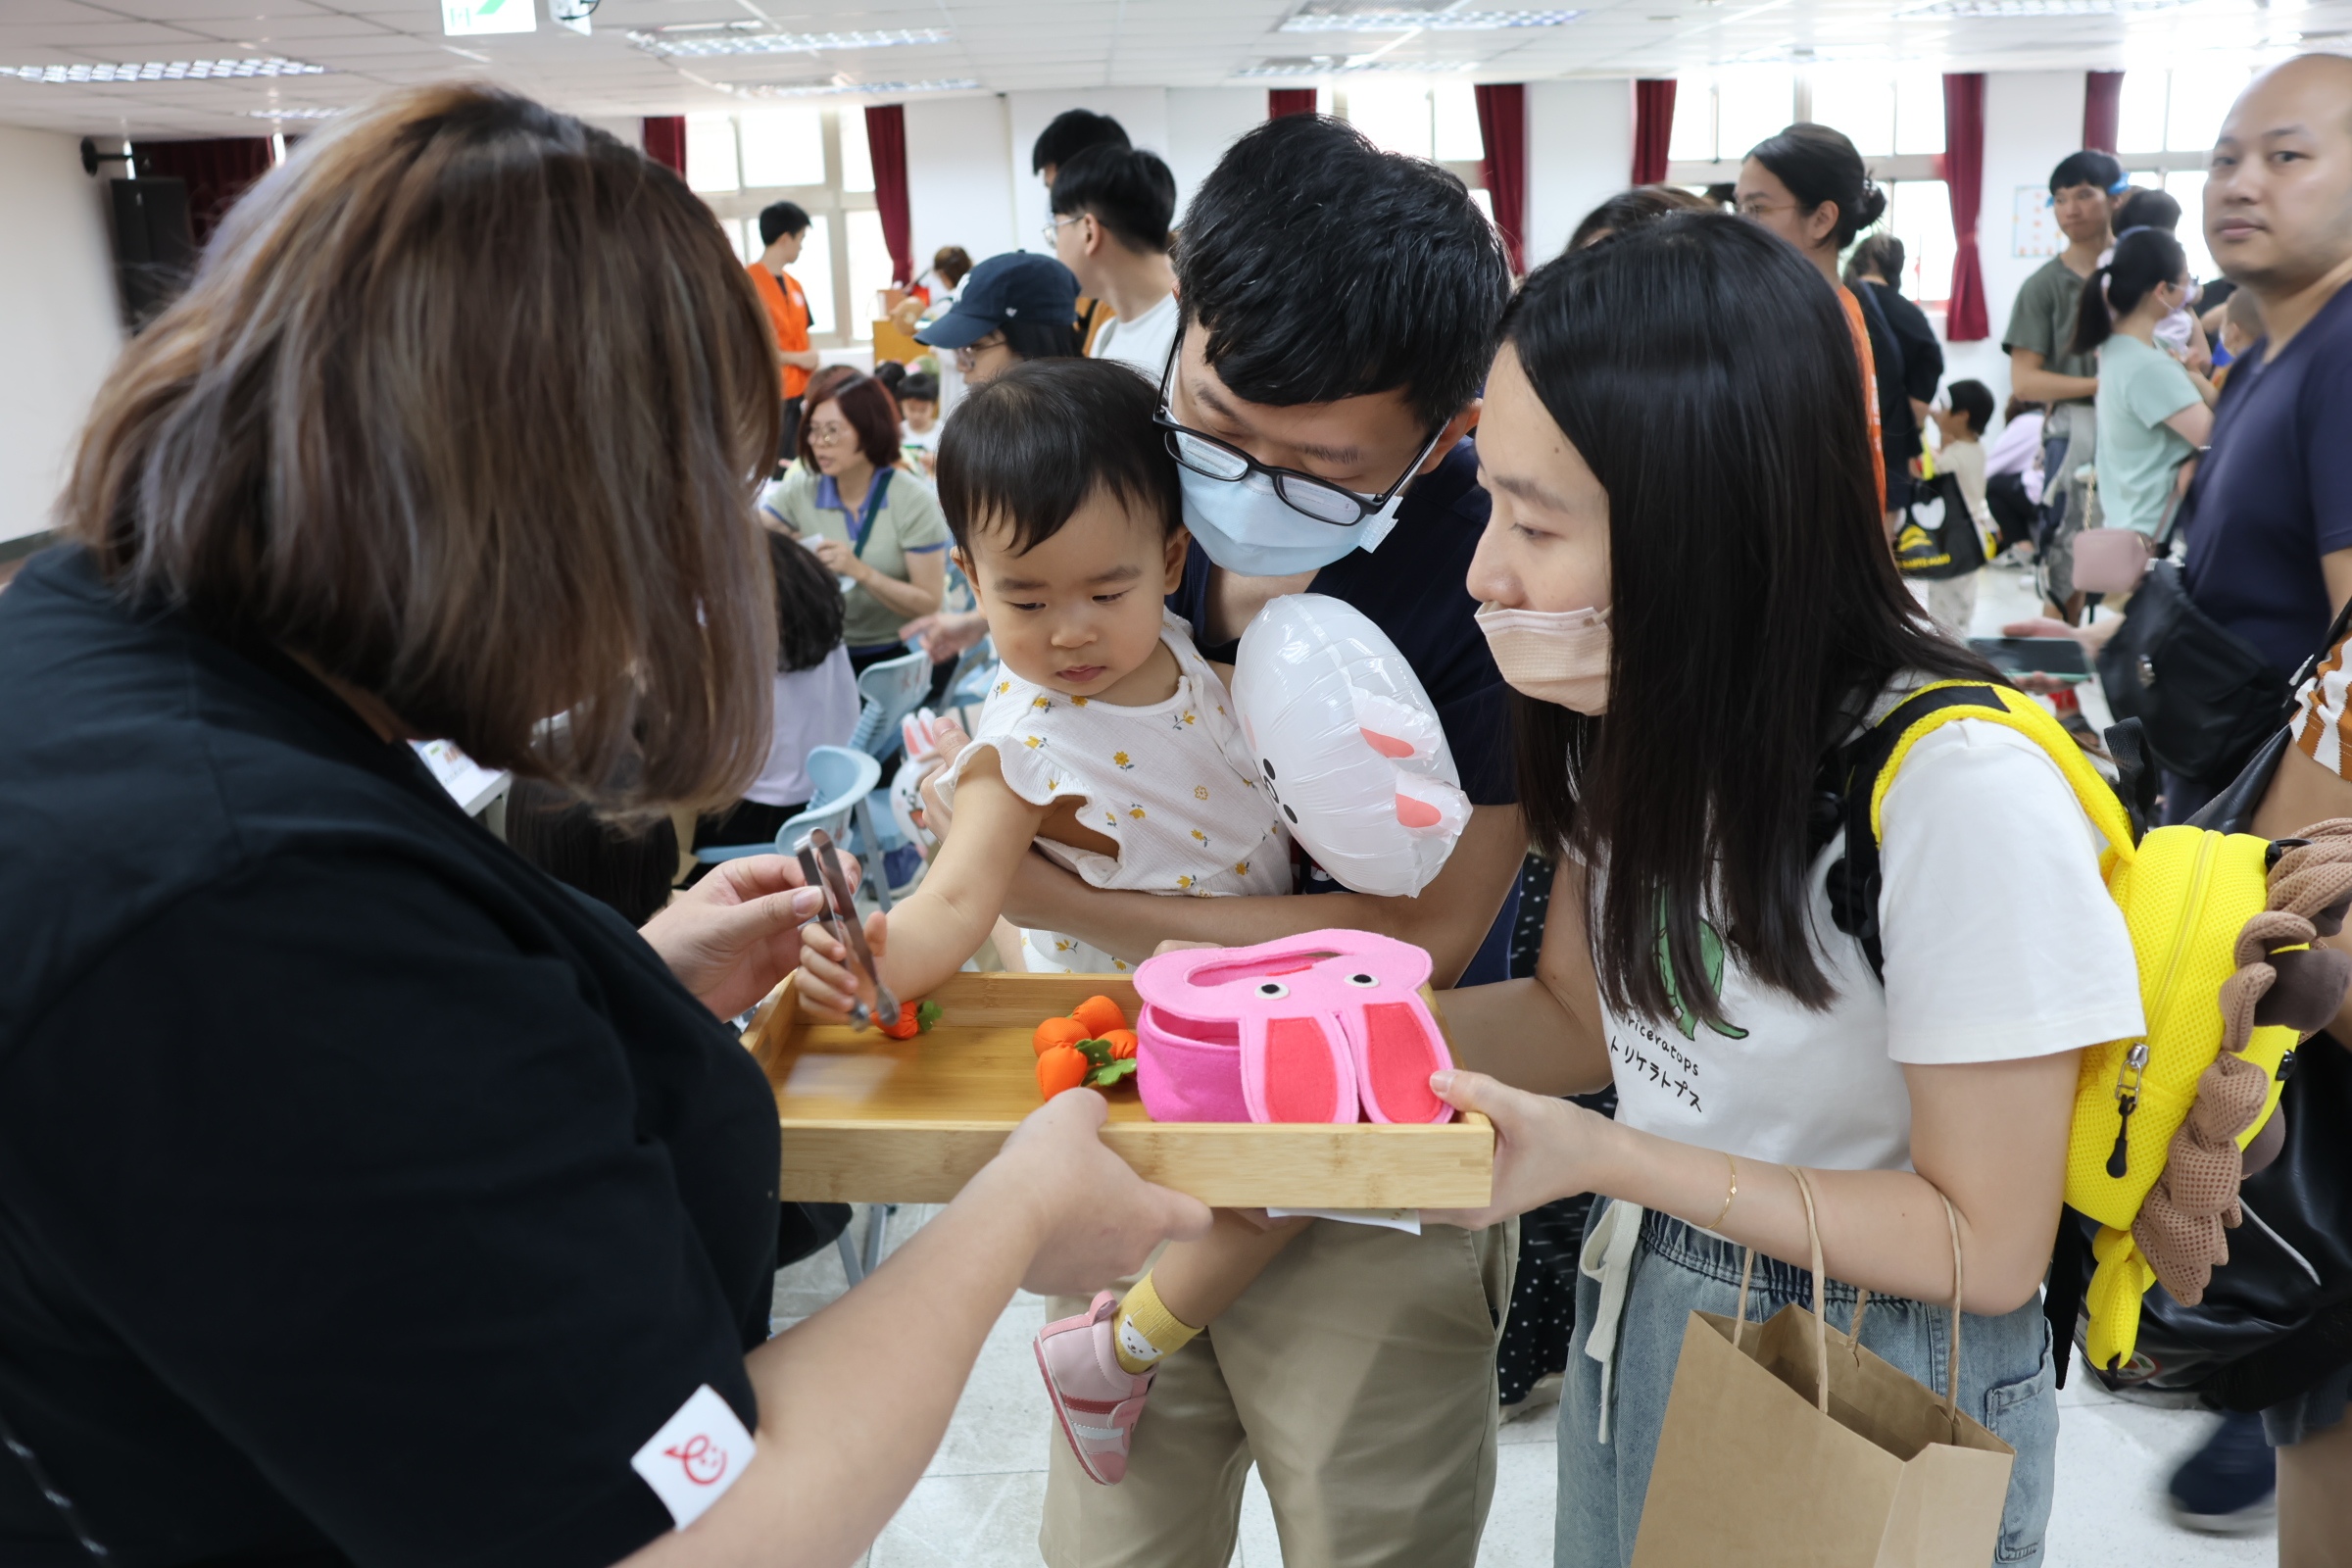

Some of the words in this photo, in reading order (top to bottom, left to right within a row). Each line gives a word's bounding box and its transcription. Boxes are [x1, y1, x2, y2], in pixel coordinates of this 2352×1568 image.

[1610, 1035, 1702, 1113] トリケラトプス
